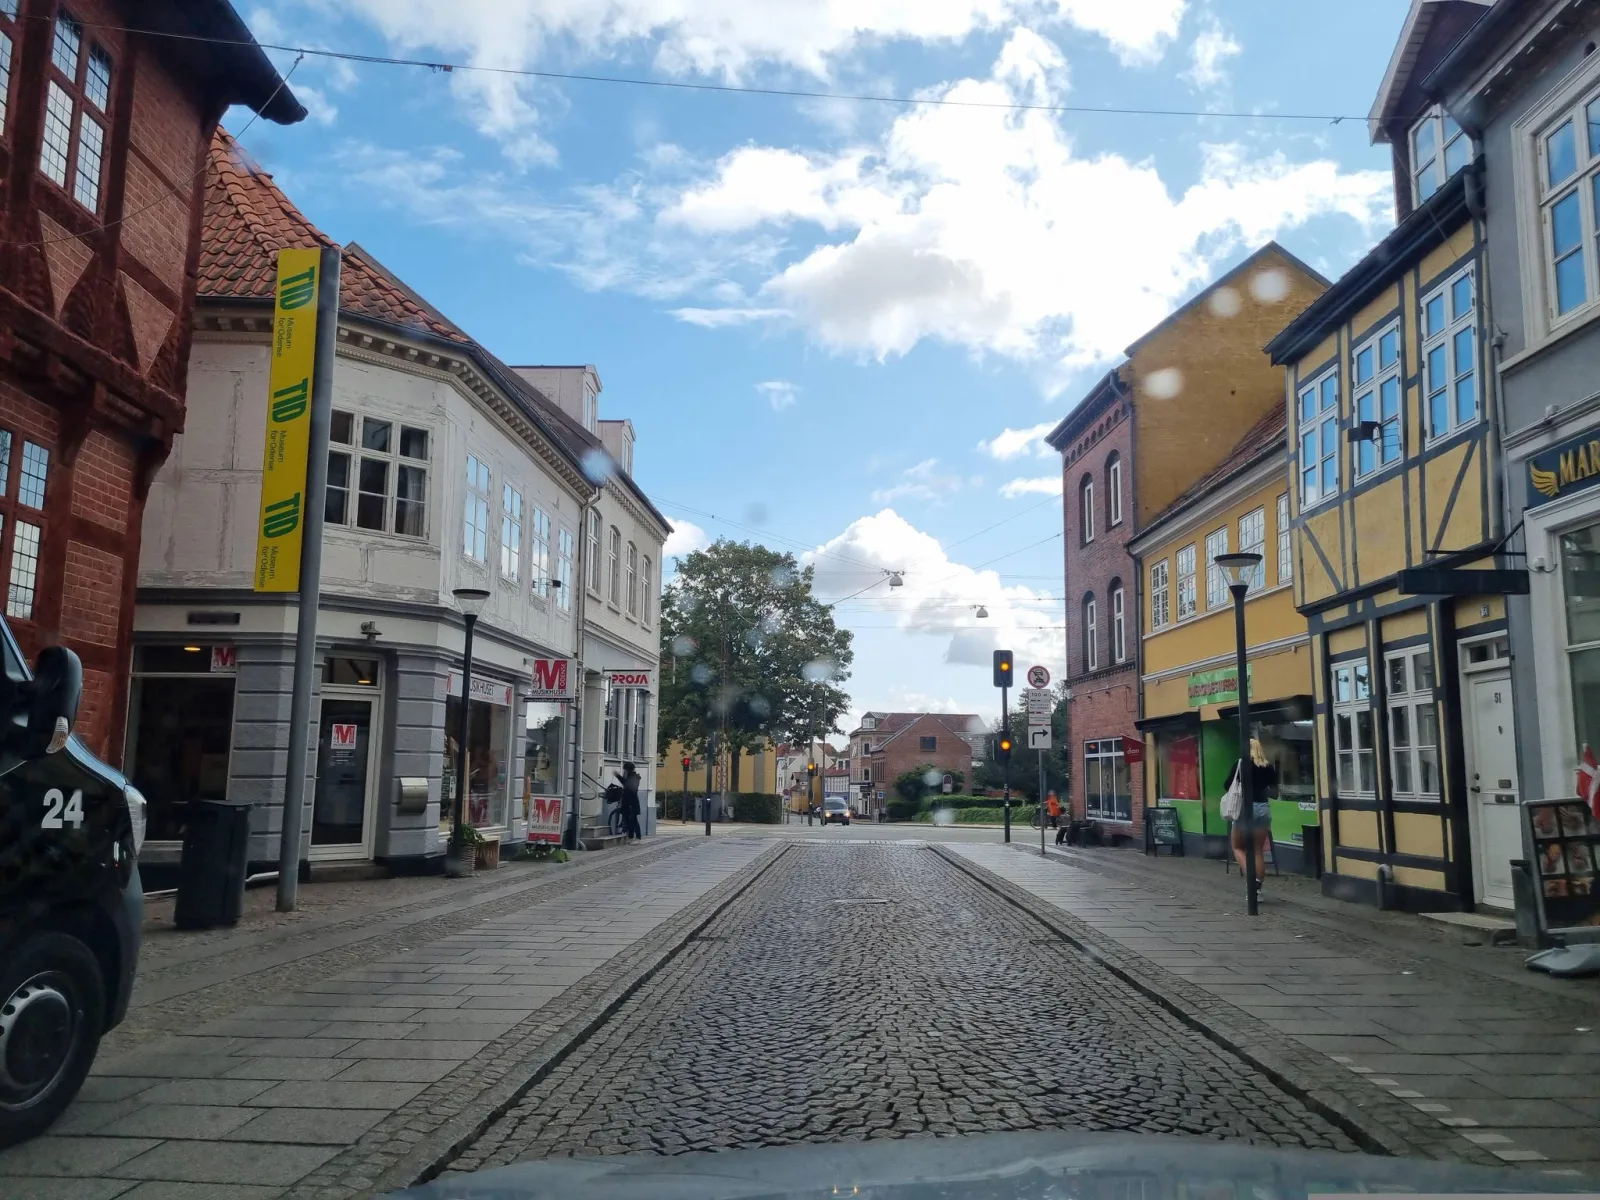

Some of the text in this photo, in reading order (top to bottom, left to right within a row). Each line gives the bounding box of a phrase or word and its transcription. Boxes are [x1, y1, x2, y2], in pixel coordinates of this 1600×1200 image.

[280, 266, 315, 310] TID
[277, 329, 285, 357] Odense
[286, 317, 294, 349] Museum
[272, 378, 308, 422] TID
[268, 443, 277, 472] Odense
[278, 430, 287, 463] Museum
[263, 492, 300, 538] TID
[259, 546, 269, 588] for Odense
[269, 546, 278, 580] Museum
[611, 674, 648, 684] PROSA
[1494, 692, 1502, 704] 51
[41, 788, 85, 829] 24
